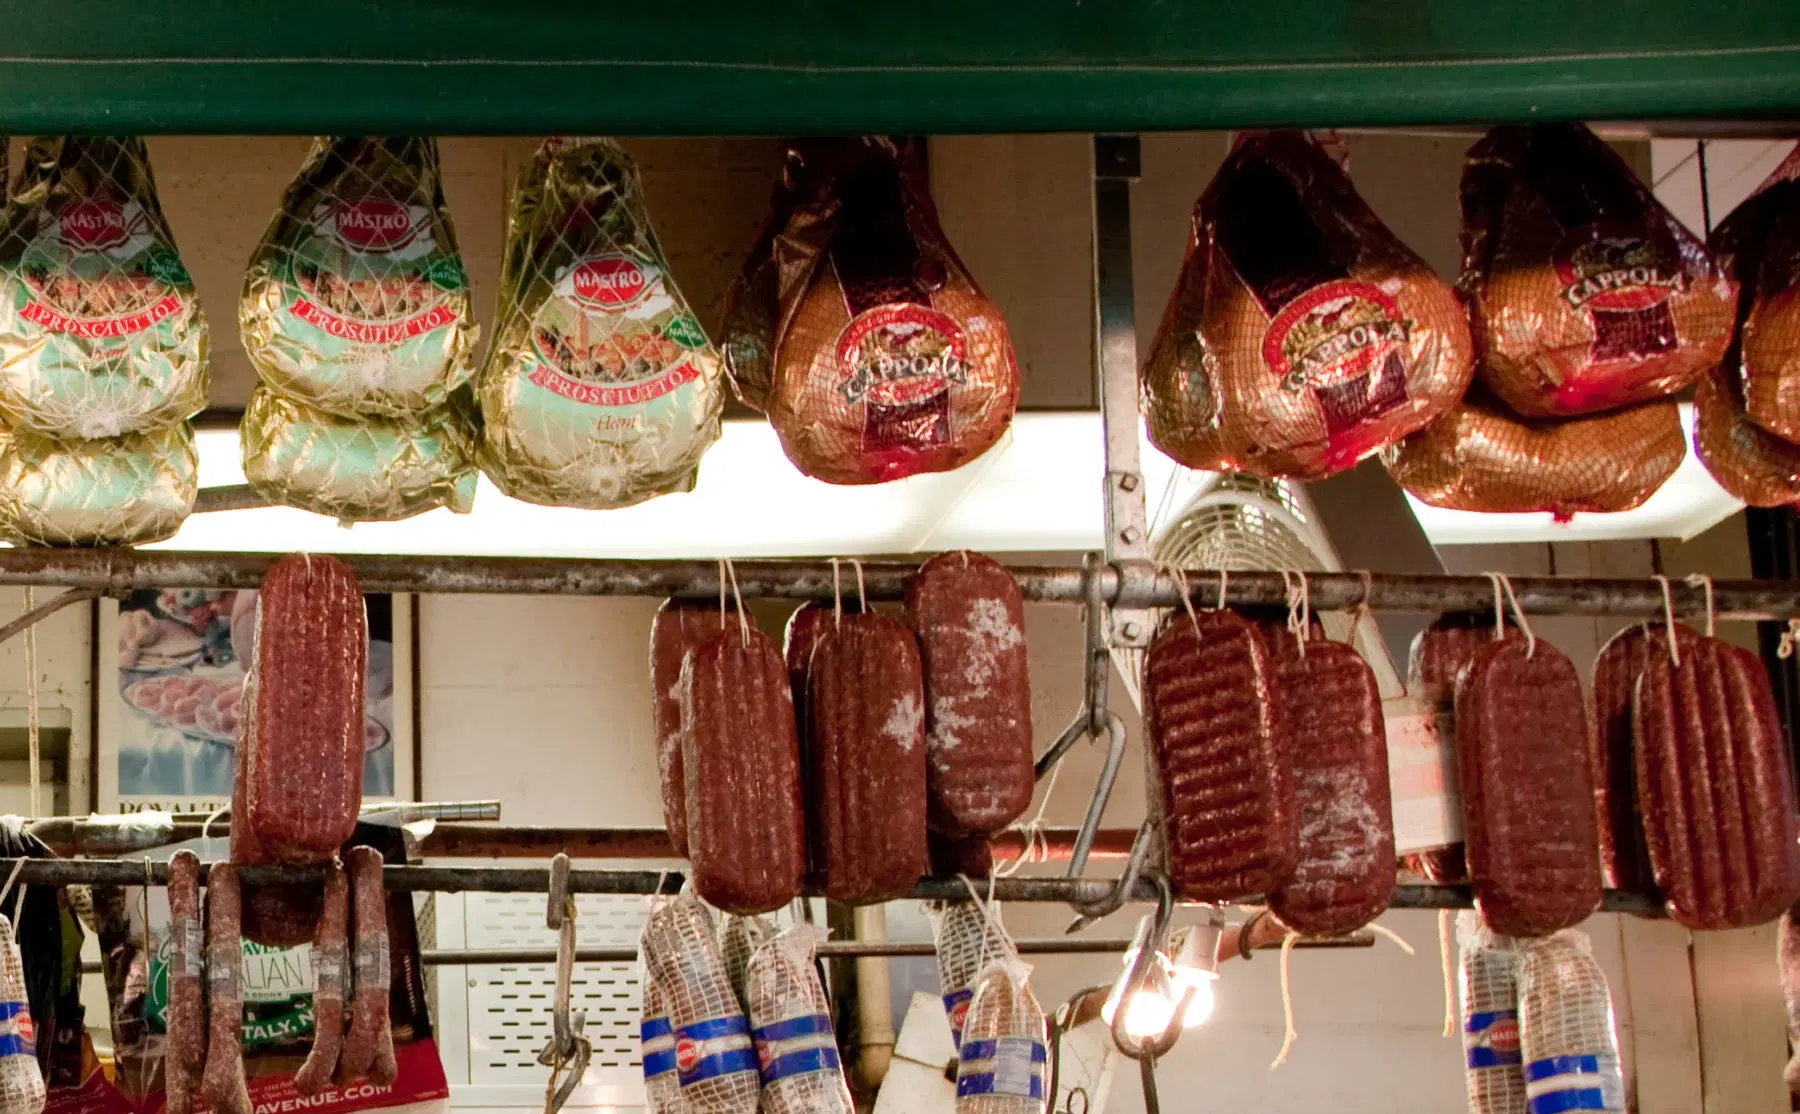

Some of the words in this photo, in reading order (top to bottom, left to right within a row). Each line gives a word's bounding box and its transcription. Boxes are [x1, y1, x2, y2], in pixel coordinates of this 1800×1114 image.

[62, 211, 124, 229] MASTRO
[338, 211, 408, 231] MASTRO
[575, 270, 643, 289] MASTRO
[1566, 266, 1685, 305] CAPPOLA
[36, 303, 169, 337] PROSCIUTTO
[304, 306, 441, 343] PROSCIUTTO
[1284, 318, 1406, 391] CAPPOLA
[544, 370, 684, 407] PROSCIUTTO
